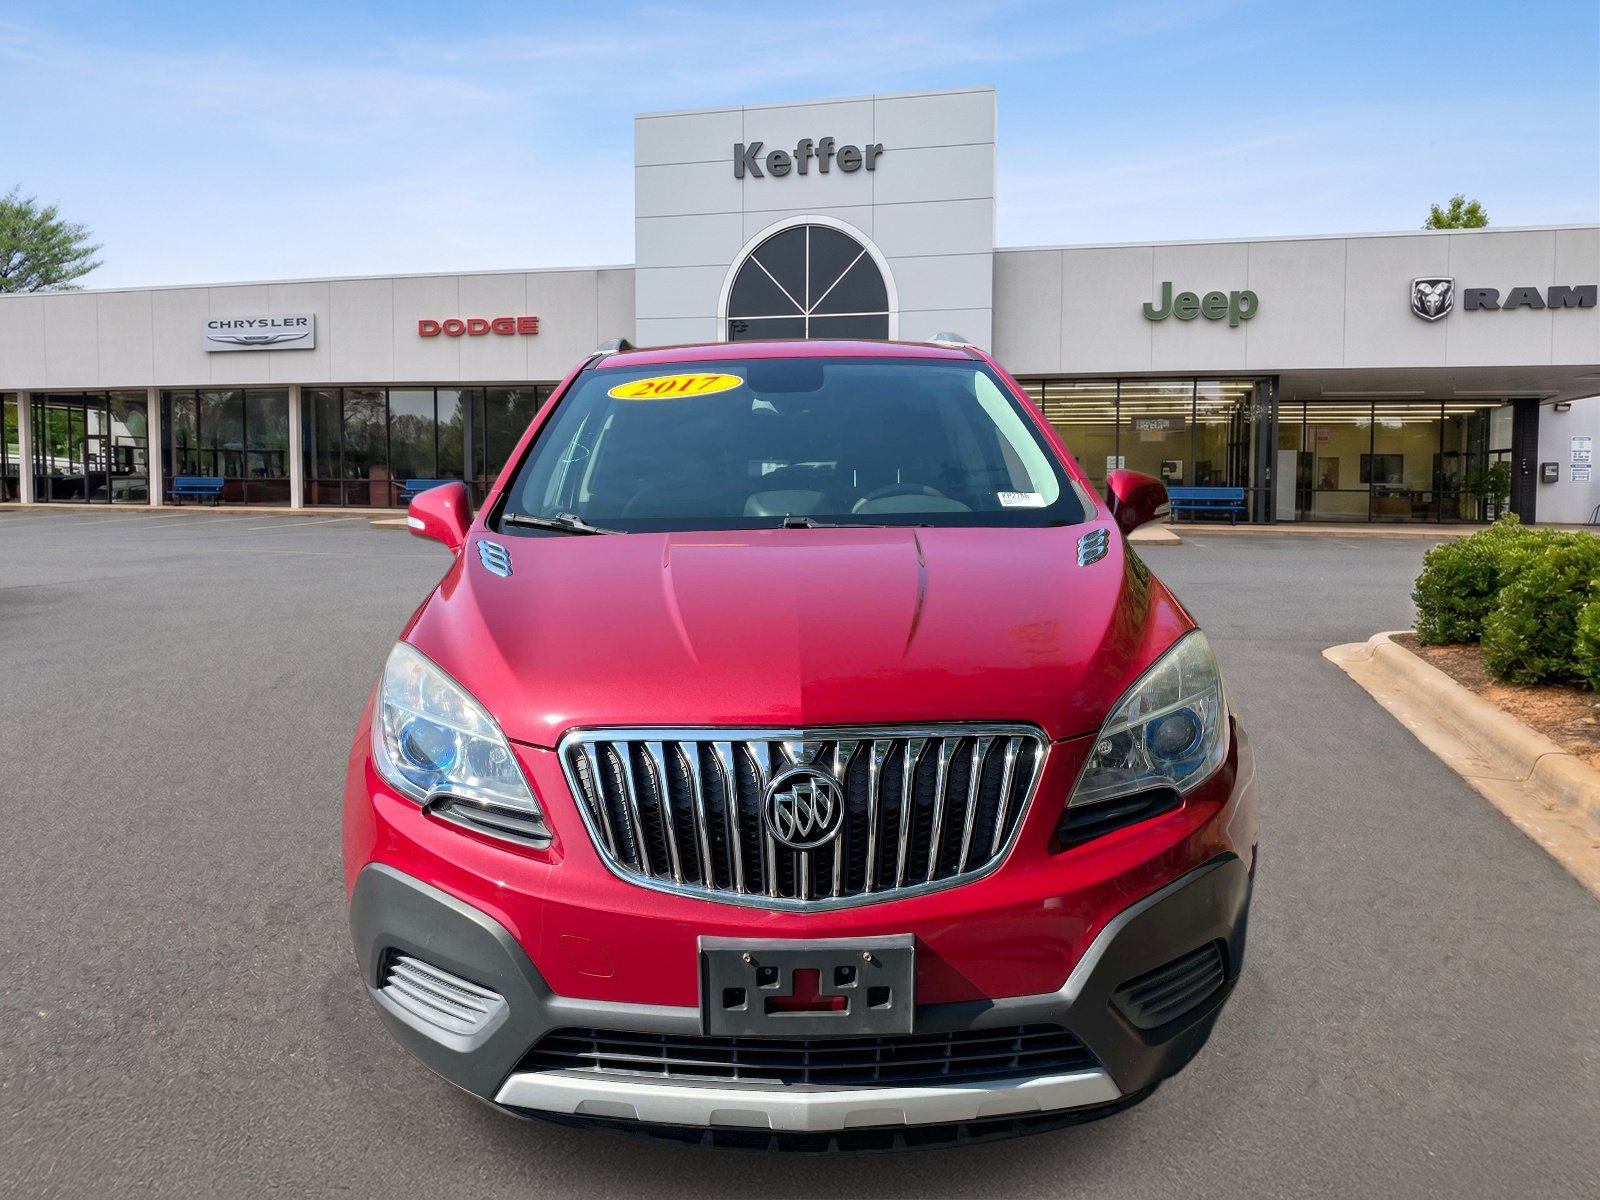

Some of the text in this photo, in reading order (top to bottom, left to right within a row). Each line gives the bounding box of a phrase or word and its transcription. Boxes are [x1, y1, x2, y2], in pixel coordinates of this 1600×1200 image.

[733, 136, 883, 178] Keffer
[1142, 281, 1259, 327] Jeep
[1463, 284, 1598, 311] RAM
[207, 317, 308, 330] CHRYSLER
[418, 316, 539, 337] DODGE
[629, 376, 721, 396] 2017
